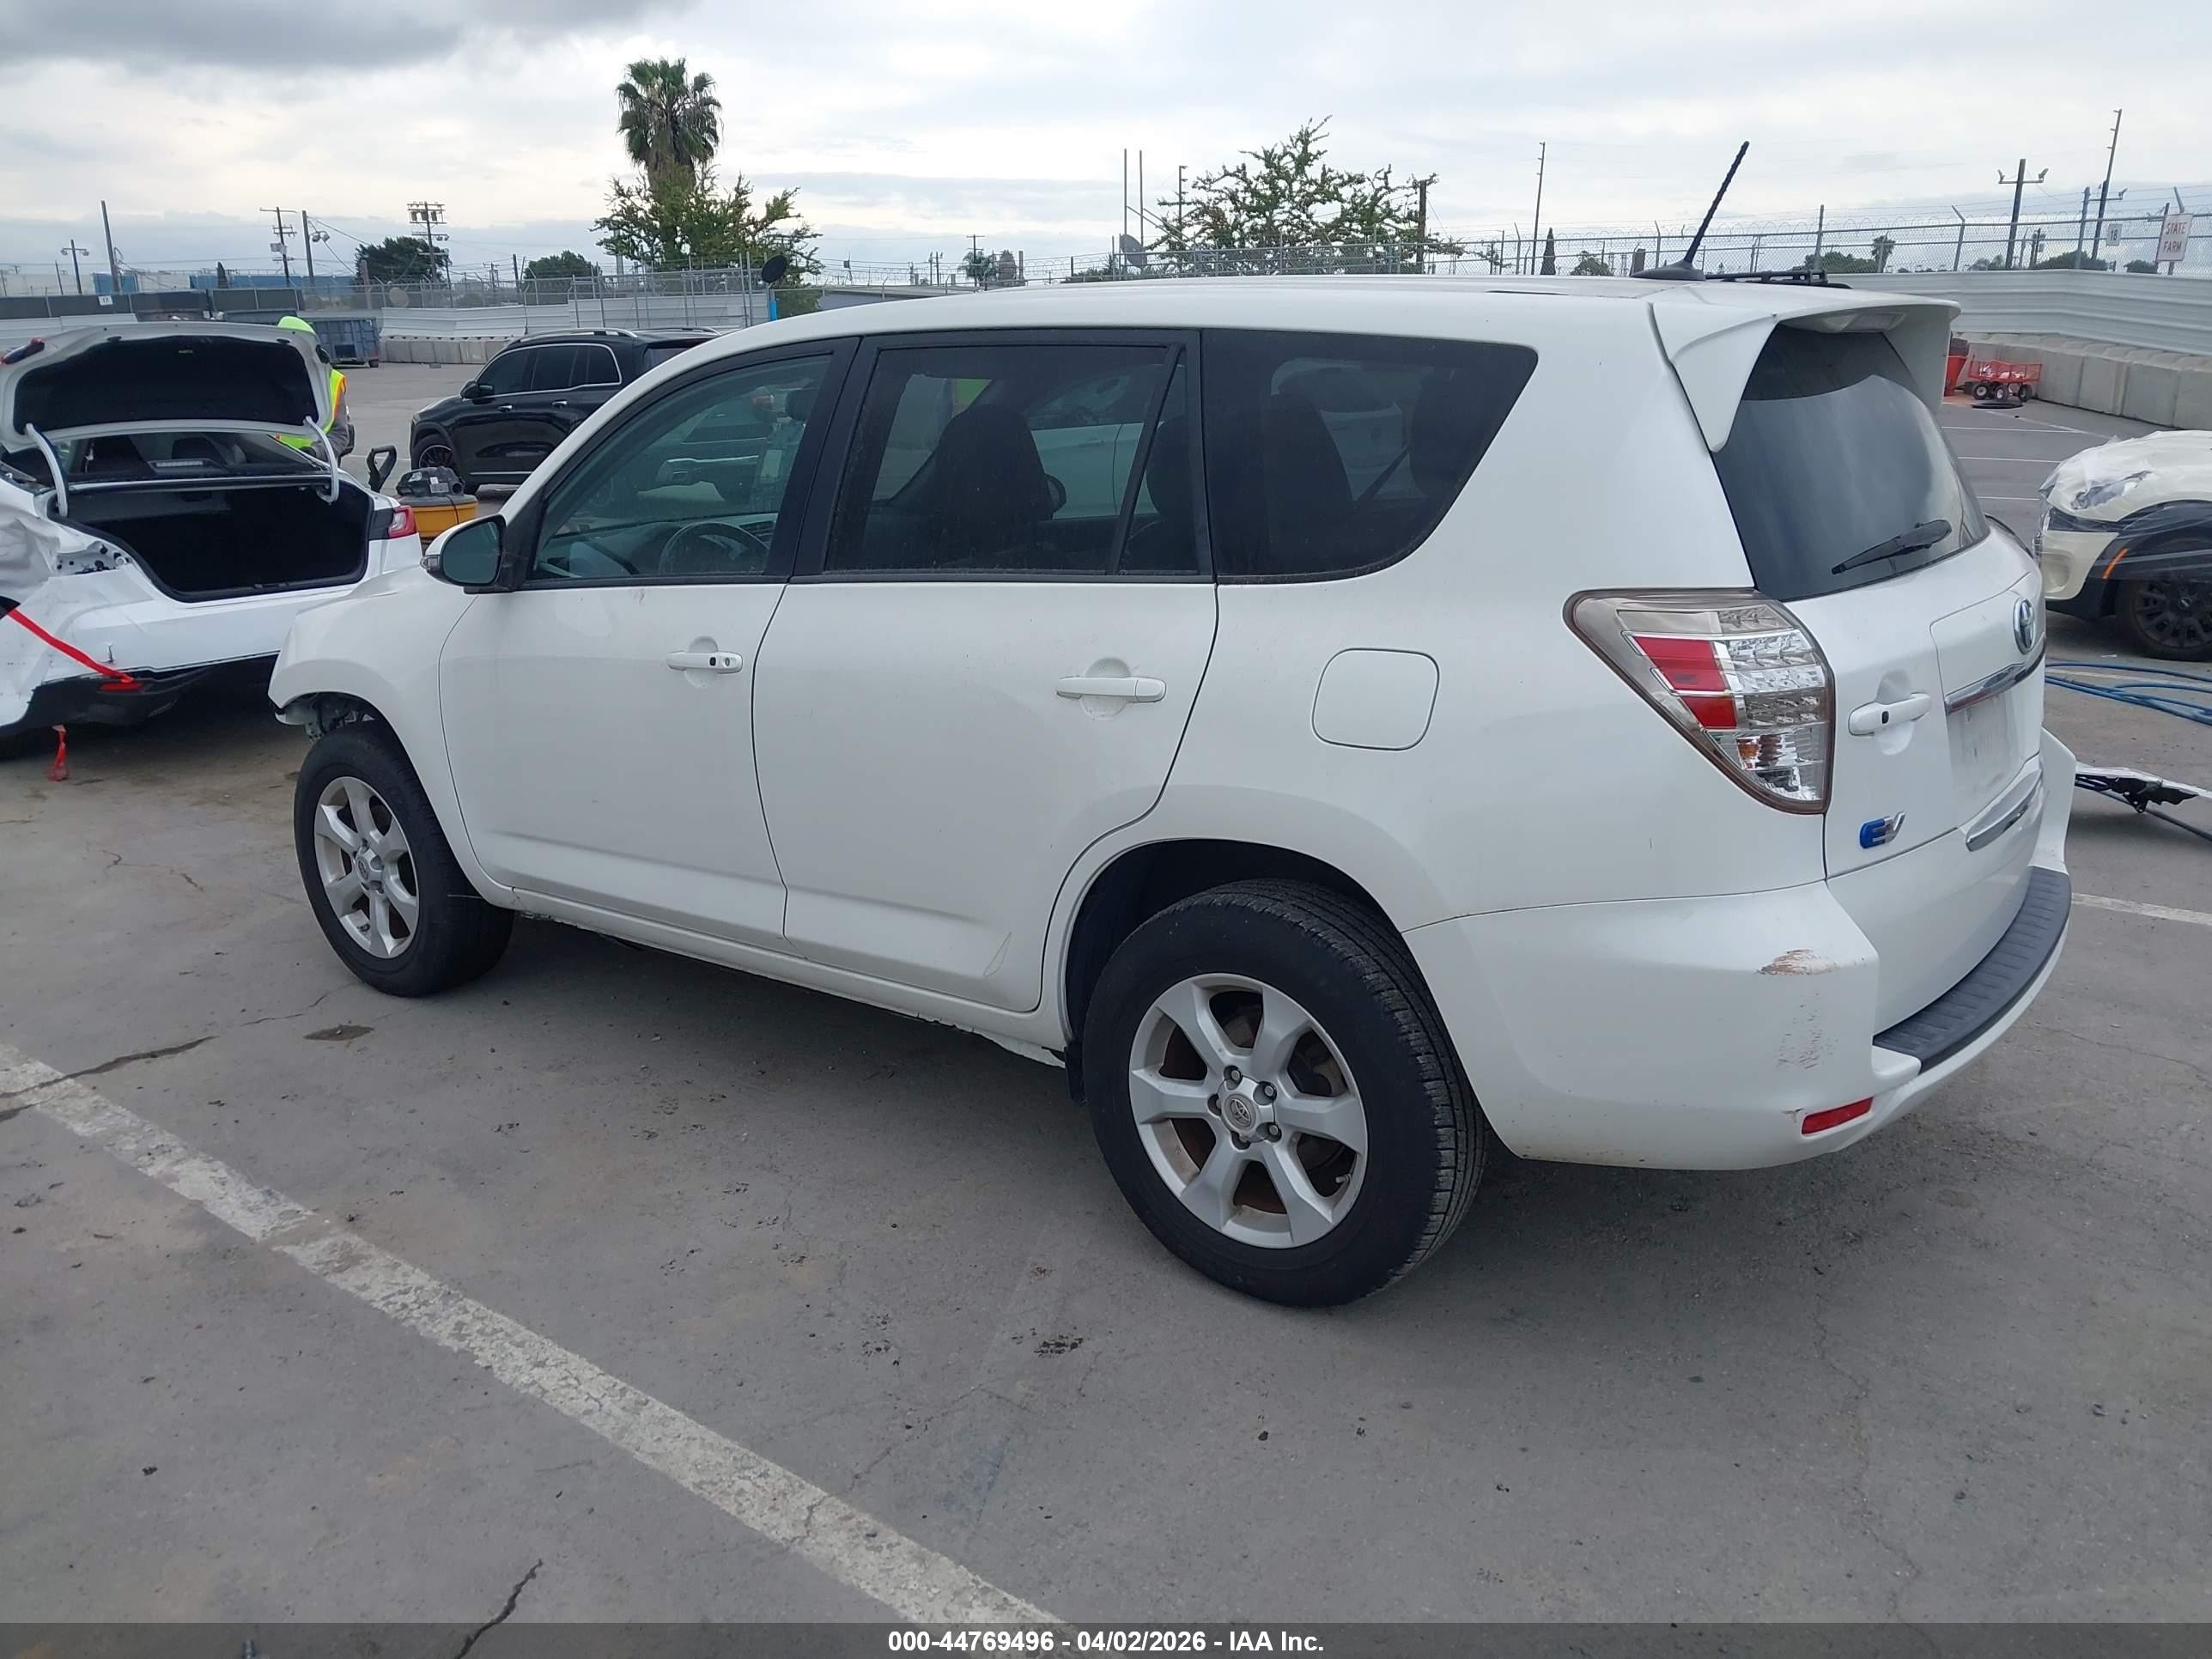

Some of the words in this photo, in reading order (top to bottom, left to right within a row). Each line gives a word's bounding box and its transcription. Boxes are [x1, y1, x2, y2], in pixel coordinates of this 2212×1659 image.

[2166, 222, 2187, 234] STATE
[2163, 240, 2183, 253] FARM
[1859, 811, 1905, 848] EV
